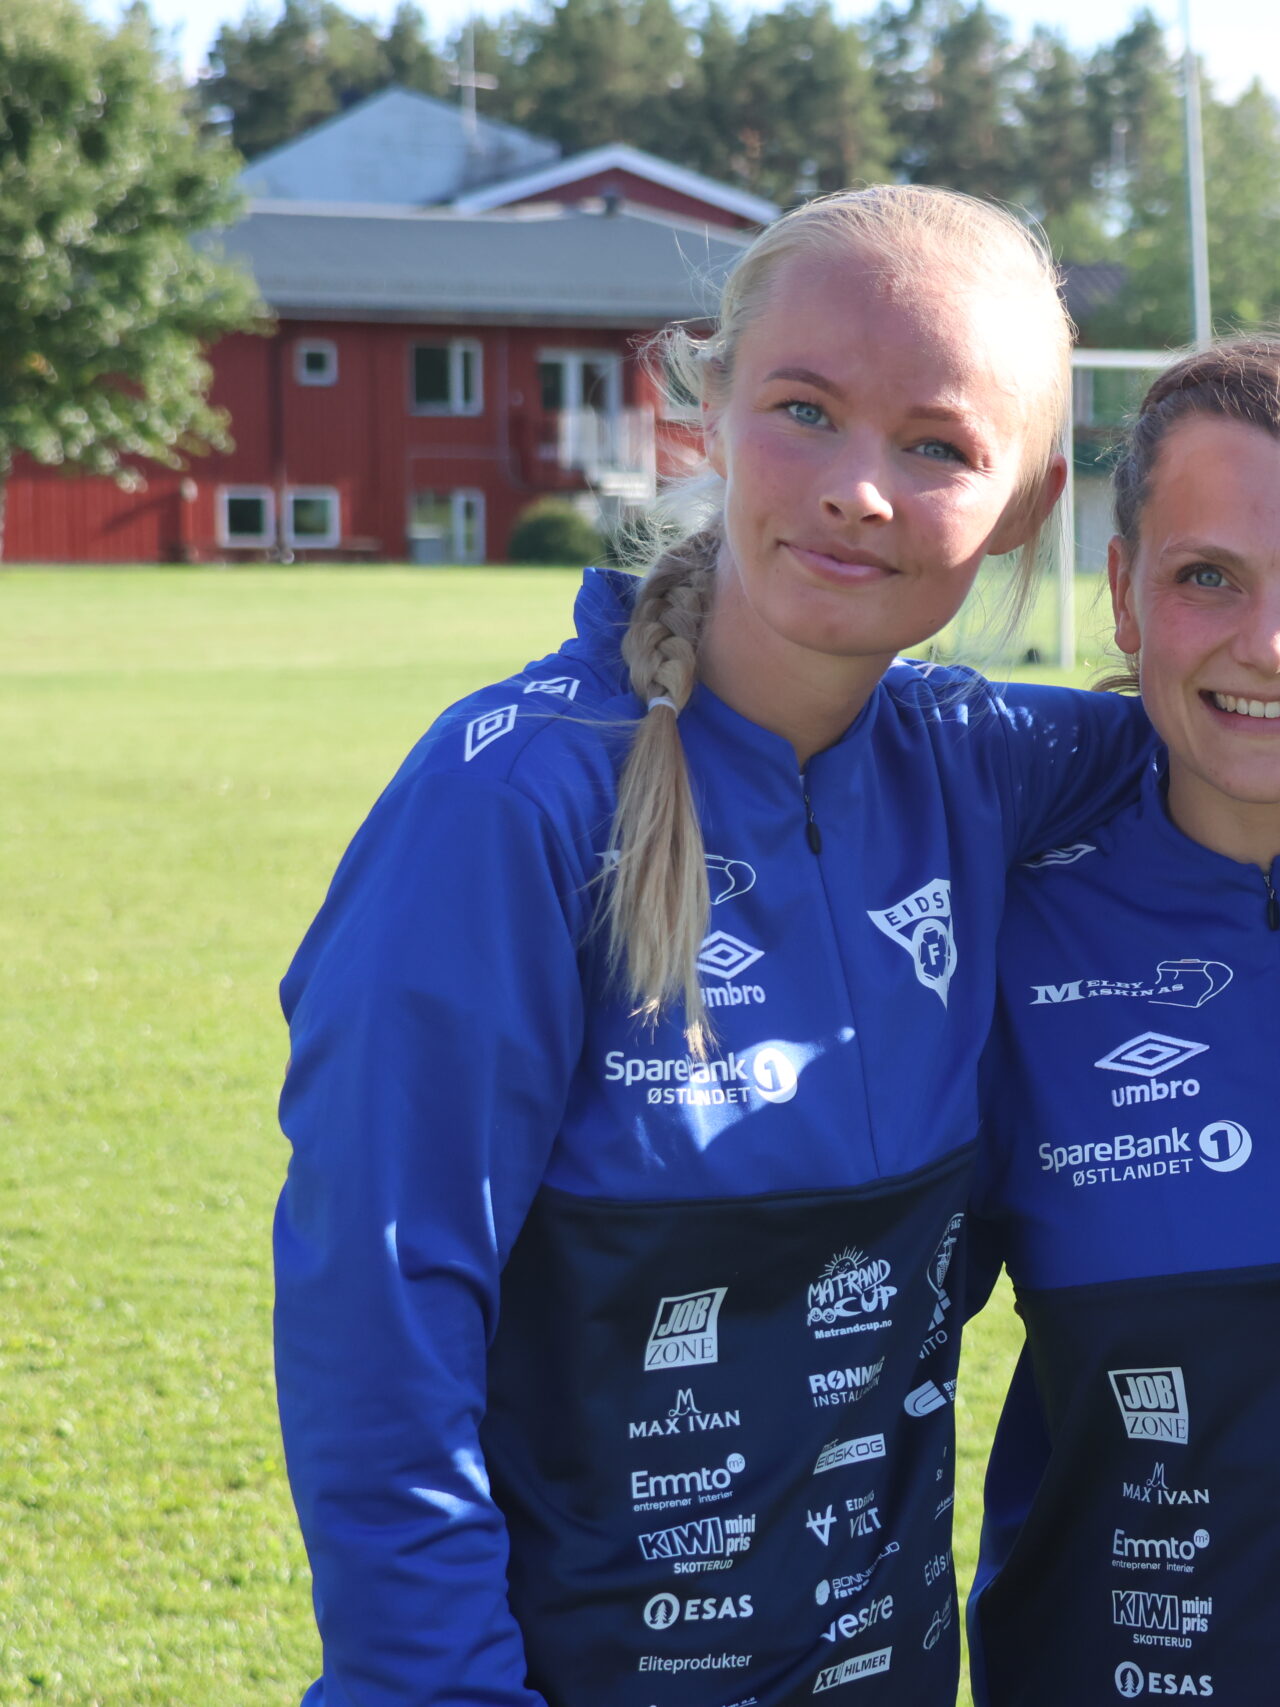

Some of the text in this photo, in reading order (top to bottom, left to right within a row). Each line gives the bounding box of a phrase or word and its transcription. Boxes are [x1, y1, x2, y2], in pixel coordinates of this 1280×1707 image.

[884, 889, 951, 927] EIDS
[928, 943, 940, 966] F
[605, 1050, 749, 1086] Spareank
[647, 1086, 751, 1106] ØSTLNDET
[1111, 1079, 1200, 1107] umbro
[1039, 1127, 1192, 1174] SpareBank
[1072, 1158, 1194, 1187] ØSTLANDET
[808, 1259, 890, 1308] MATRAND
[657, 1297, 711, 1337] JOB
[814, 1319, 893, 1340] Matrandcup.no
[648, 1337, 714, 1365] ZONE
[1123, 1374, 1176, 1411] JOB
[629, 1410, 741, 1439] MAX IVAN
[1126, 1414, 1187, 1440] ZONE
[816, 1439, 883, 1470] EIDSKOG
[1123, 1482, 1210, 1505] MAX IVAN
[725, 1514, 756, 1534] mini
[850, 1507, 881, 1538] VILT
[638, 1517, 724, 1560] KIWI
[726, 1534, 751, 1556] pris
[673, 1559, 733, 1575] SKOTTERUD
[1111, 1559, 1161, 1571] entreprenør
[684, 1594, 754, 1621] ESAS
[820, 1594, 894, 1642] vestre
[1112, 1590, 1179, 1631] KIWI
[1182, 1597, 1212, 1615] mini
[1182, 1615, 1208, 1635] pris
[1133, 1633, 1192, 1648] SKOTTERUD
[638, 1654, 752, 1674] Eliteprodukter
[816, 1654, 888, 1691] XL HILMER
[1148, 1672, 1214, 1697] ESAS
